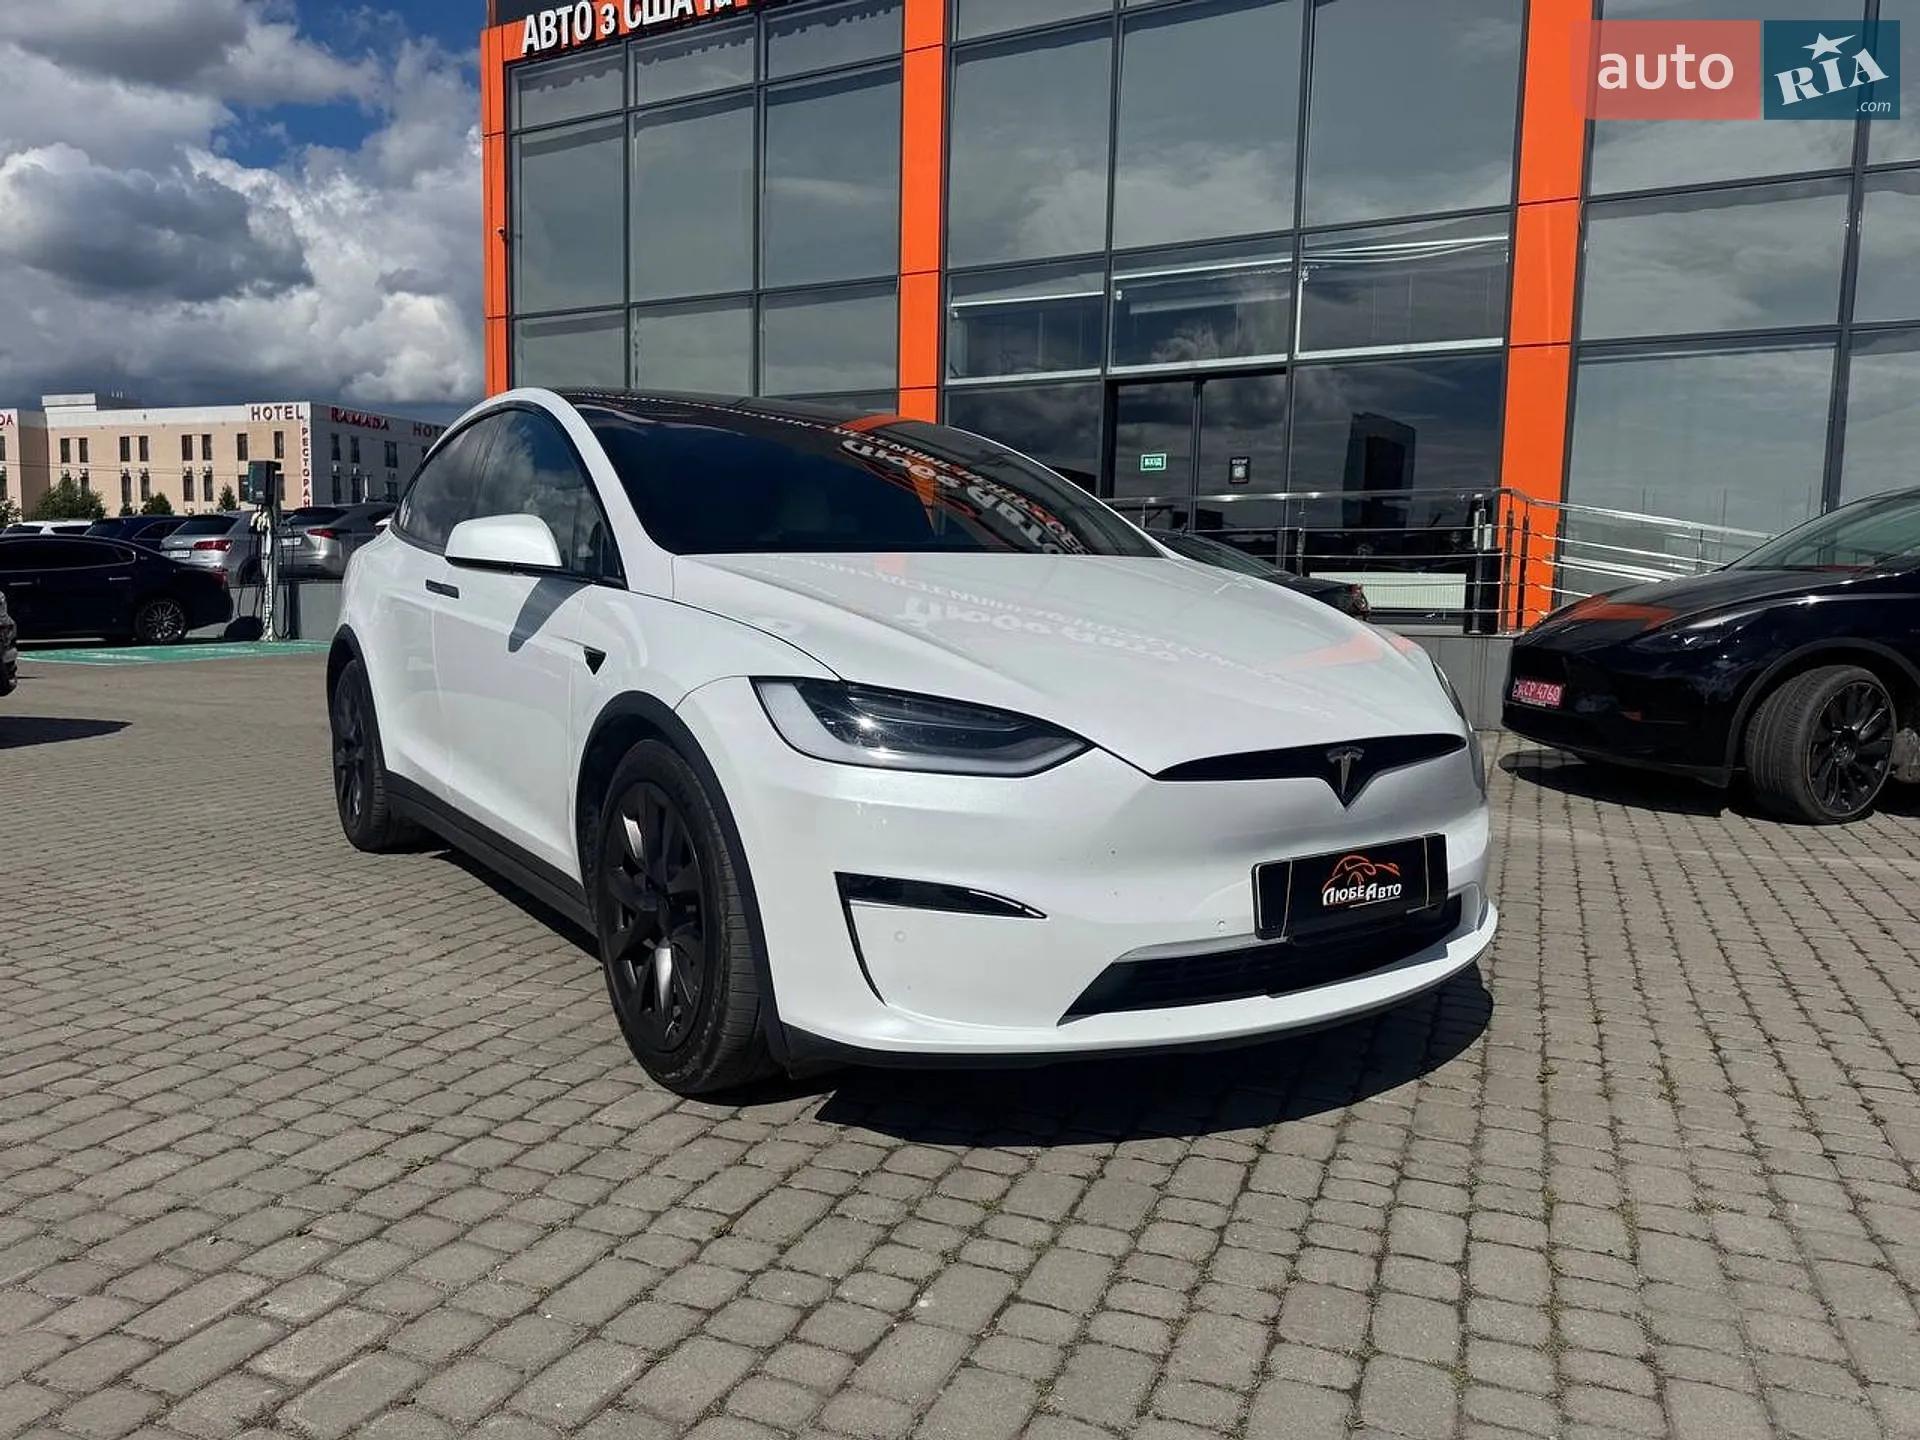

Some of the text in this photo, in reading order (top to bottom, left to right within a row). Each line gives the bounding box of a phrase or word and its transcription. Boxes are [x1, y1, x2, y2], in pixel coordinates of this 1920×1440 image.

[521, 1, 593, 54] АВТО
[600, 5, 616, 35] з
[251, 404, 304, 421] HOTEL
